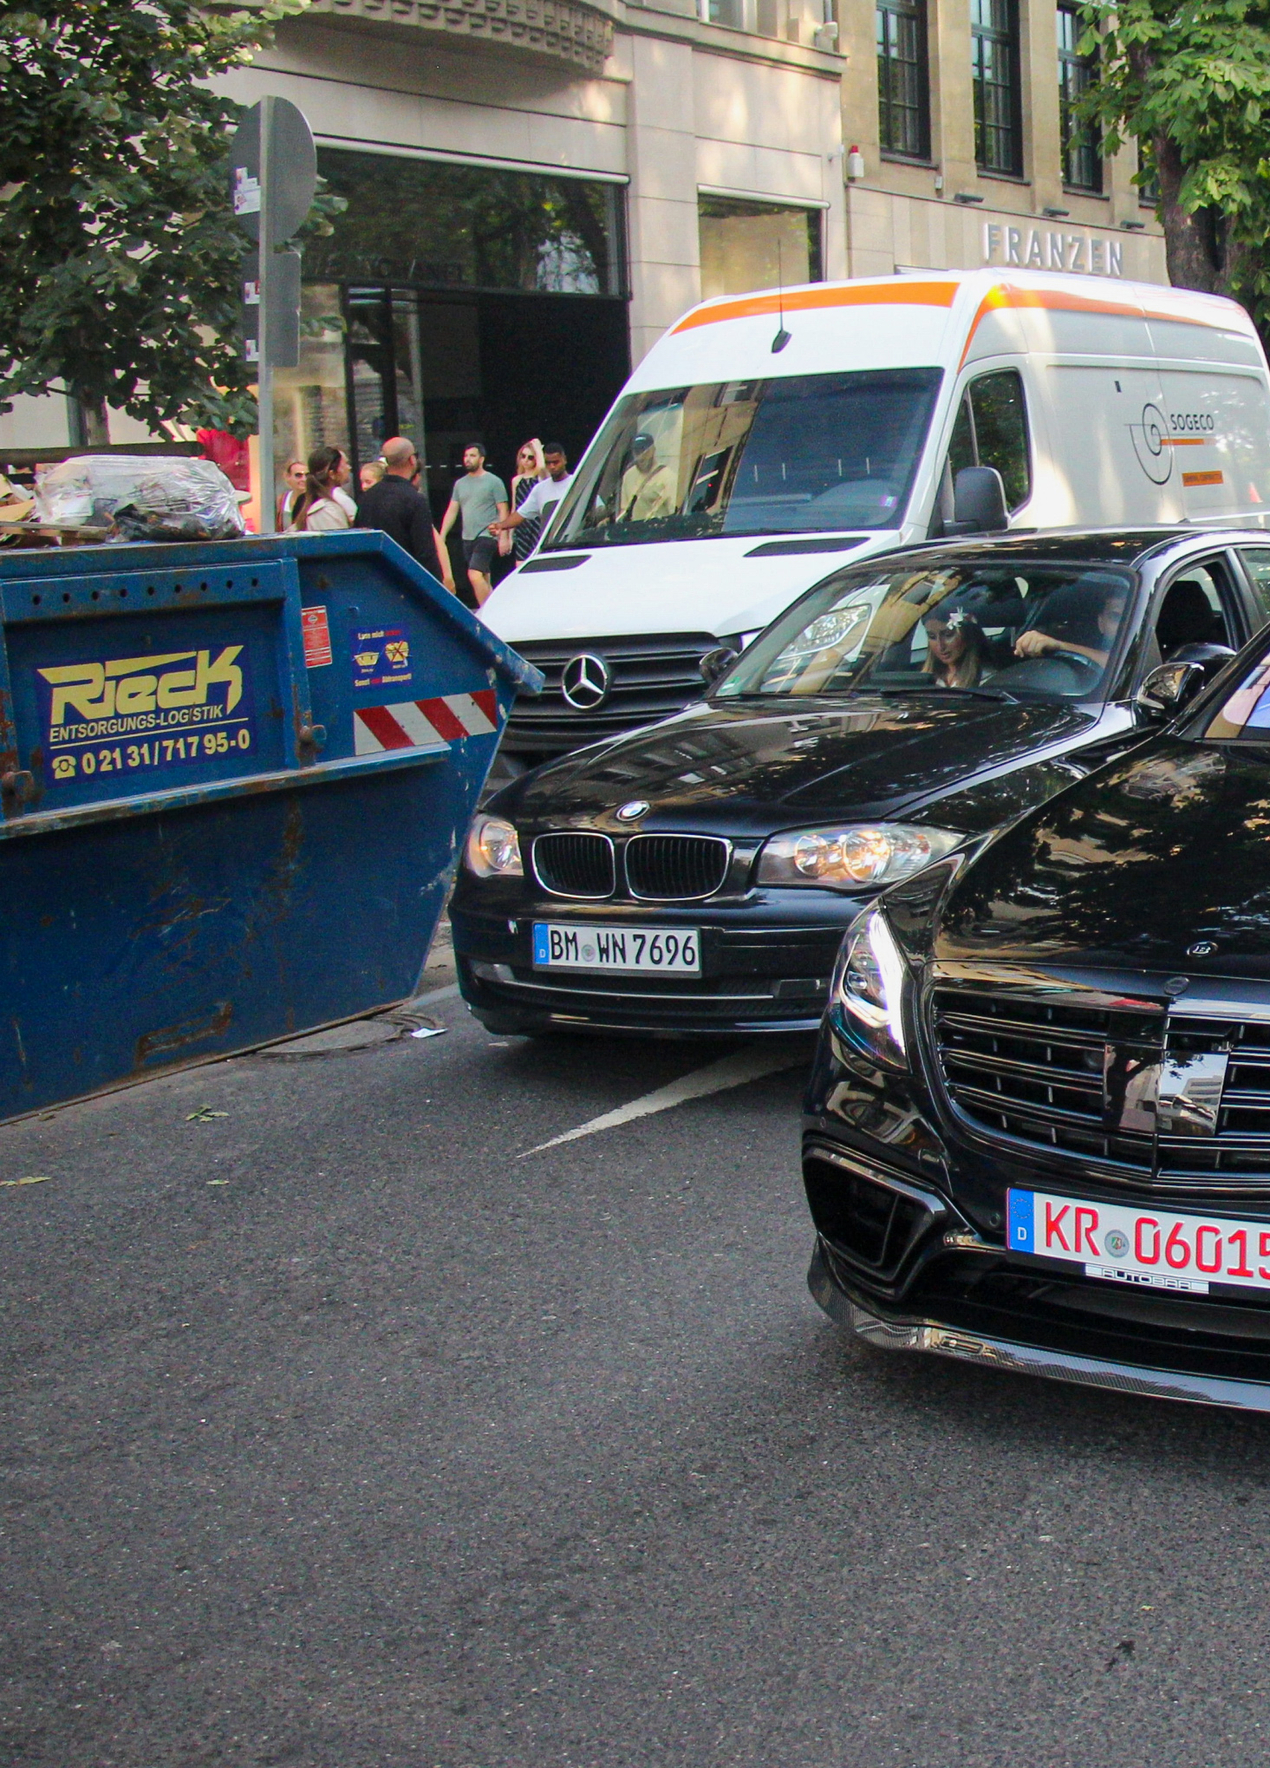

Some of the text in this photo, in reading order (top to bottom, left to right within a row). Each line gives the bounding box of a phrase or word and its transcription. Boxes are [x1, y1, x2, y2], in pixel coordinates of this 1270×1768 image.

[984, 223, 1123, 276] FRANZEN
[1170, 413, 1214, 430] SOGECO
[550, 930, 579, 961] BM
[633, 934, 696, 965] 7696
[1017, 1226, 1028, 1241] D
[1045, 1201, 1100, 1256] KR
